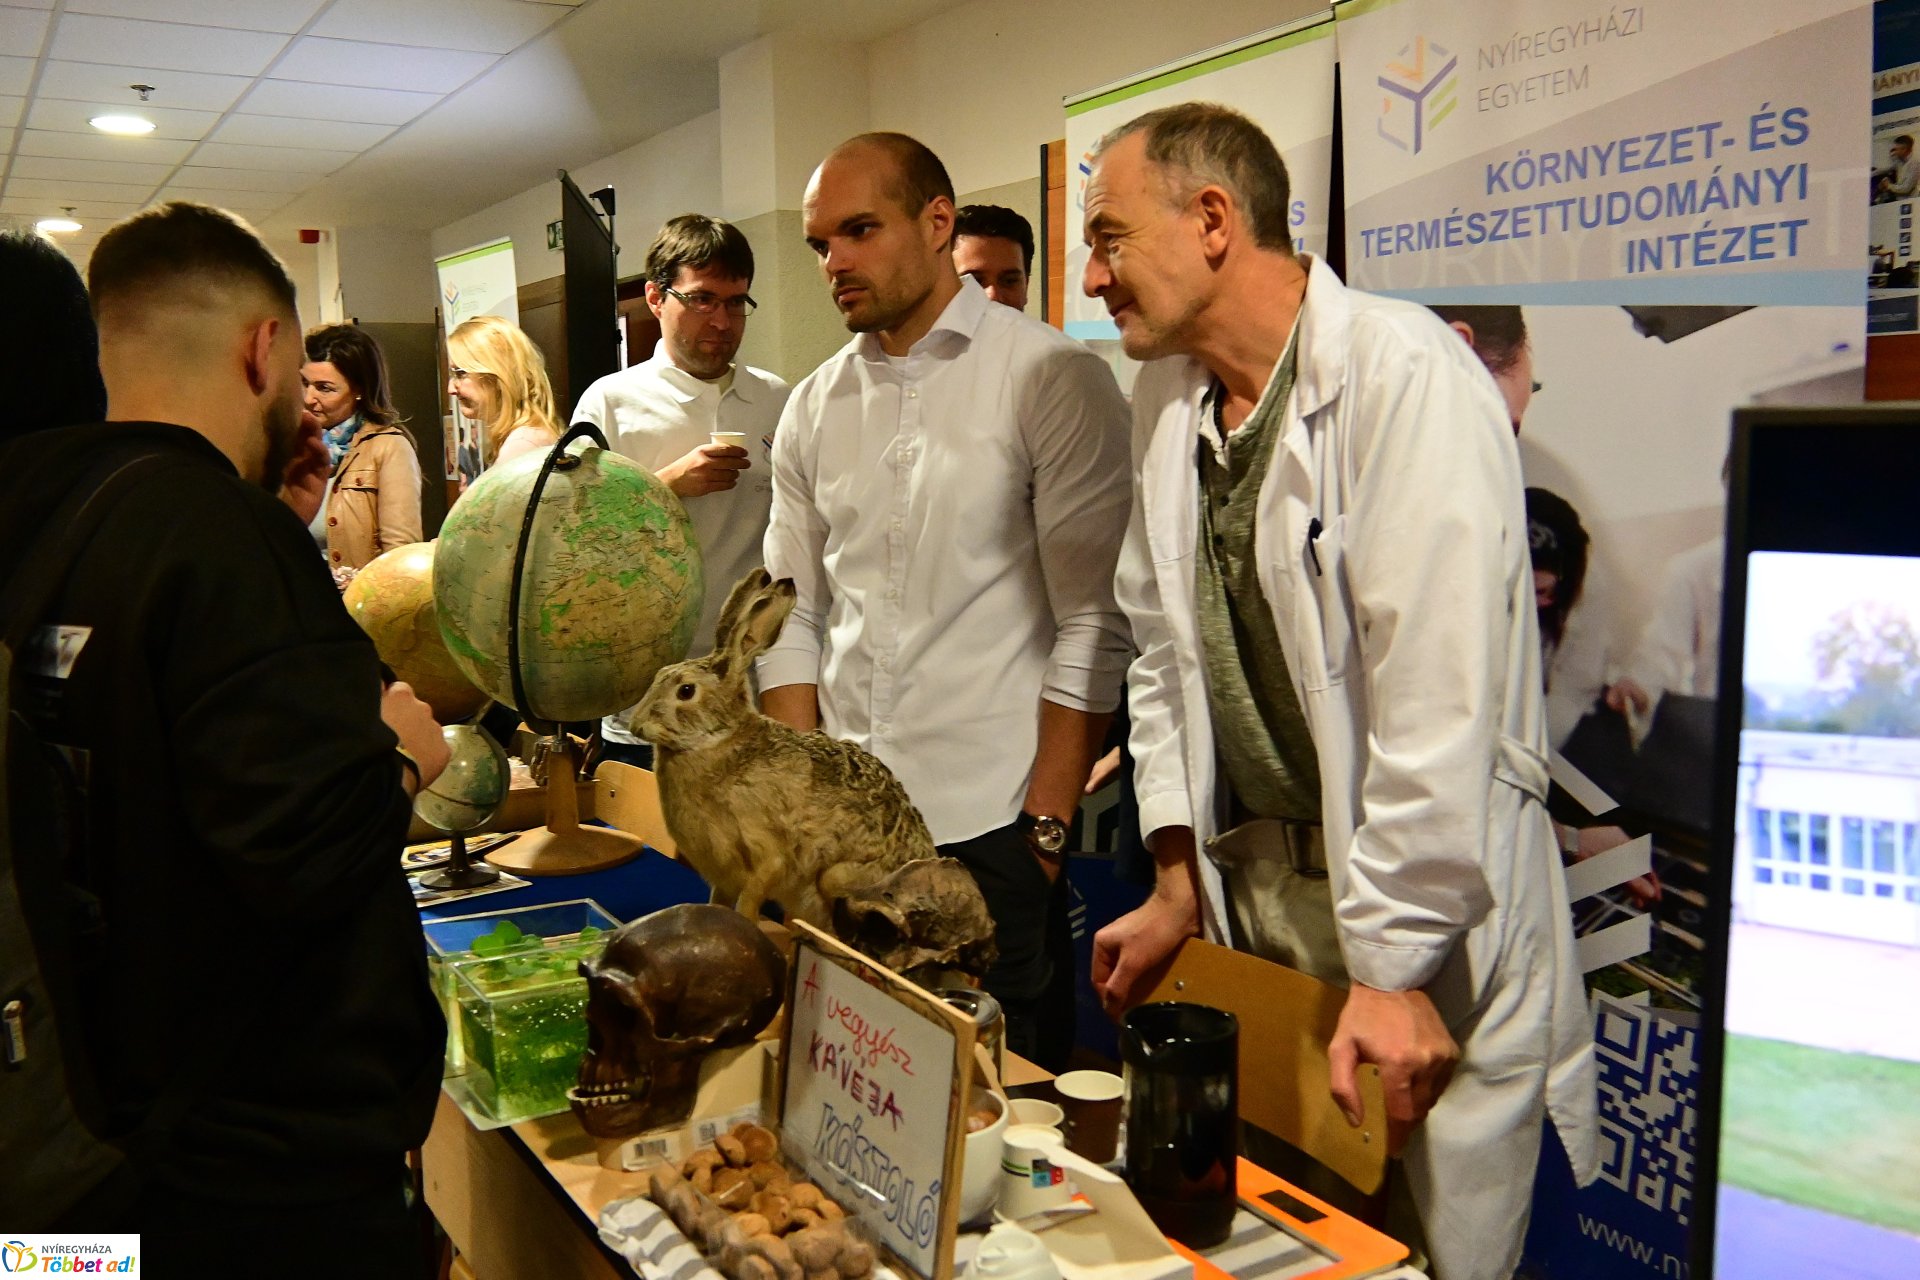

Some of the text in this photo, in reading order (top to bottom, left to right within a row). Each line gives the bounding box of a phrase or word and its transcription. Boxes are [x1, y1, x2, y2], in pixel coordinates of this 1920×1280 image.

[1477, 8, 1644, 73] NYÍREGYHÁZI
[1477, 66, 1590, 112] EGYETEM
[1487, 106, 1810, 196] KÖRNYEZET- ÉS
[1361, 163, 1809, 258] TERMÉSZETTUDOMÁNYI
[1627, 218, 1809, 273] INTÉZET
[803, 962, 821, 1006] A
[1577, 1213, 1691, 1280] www.n
